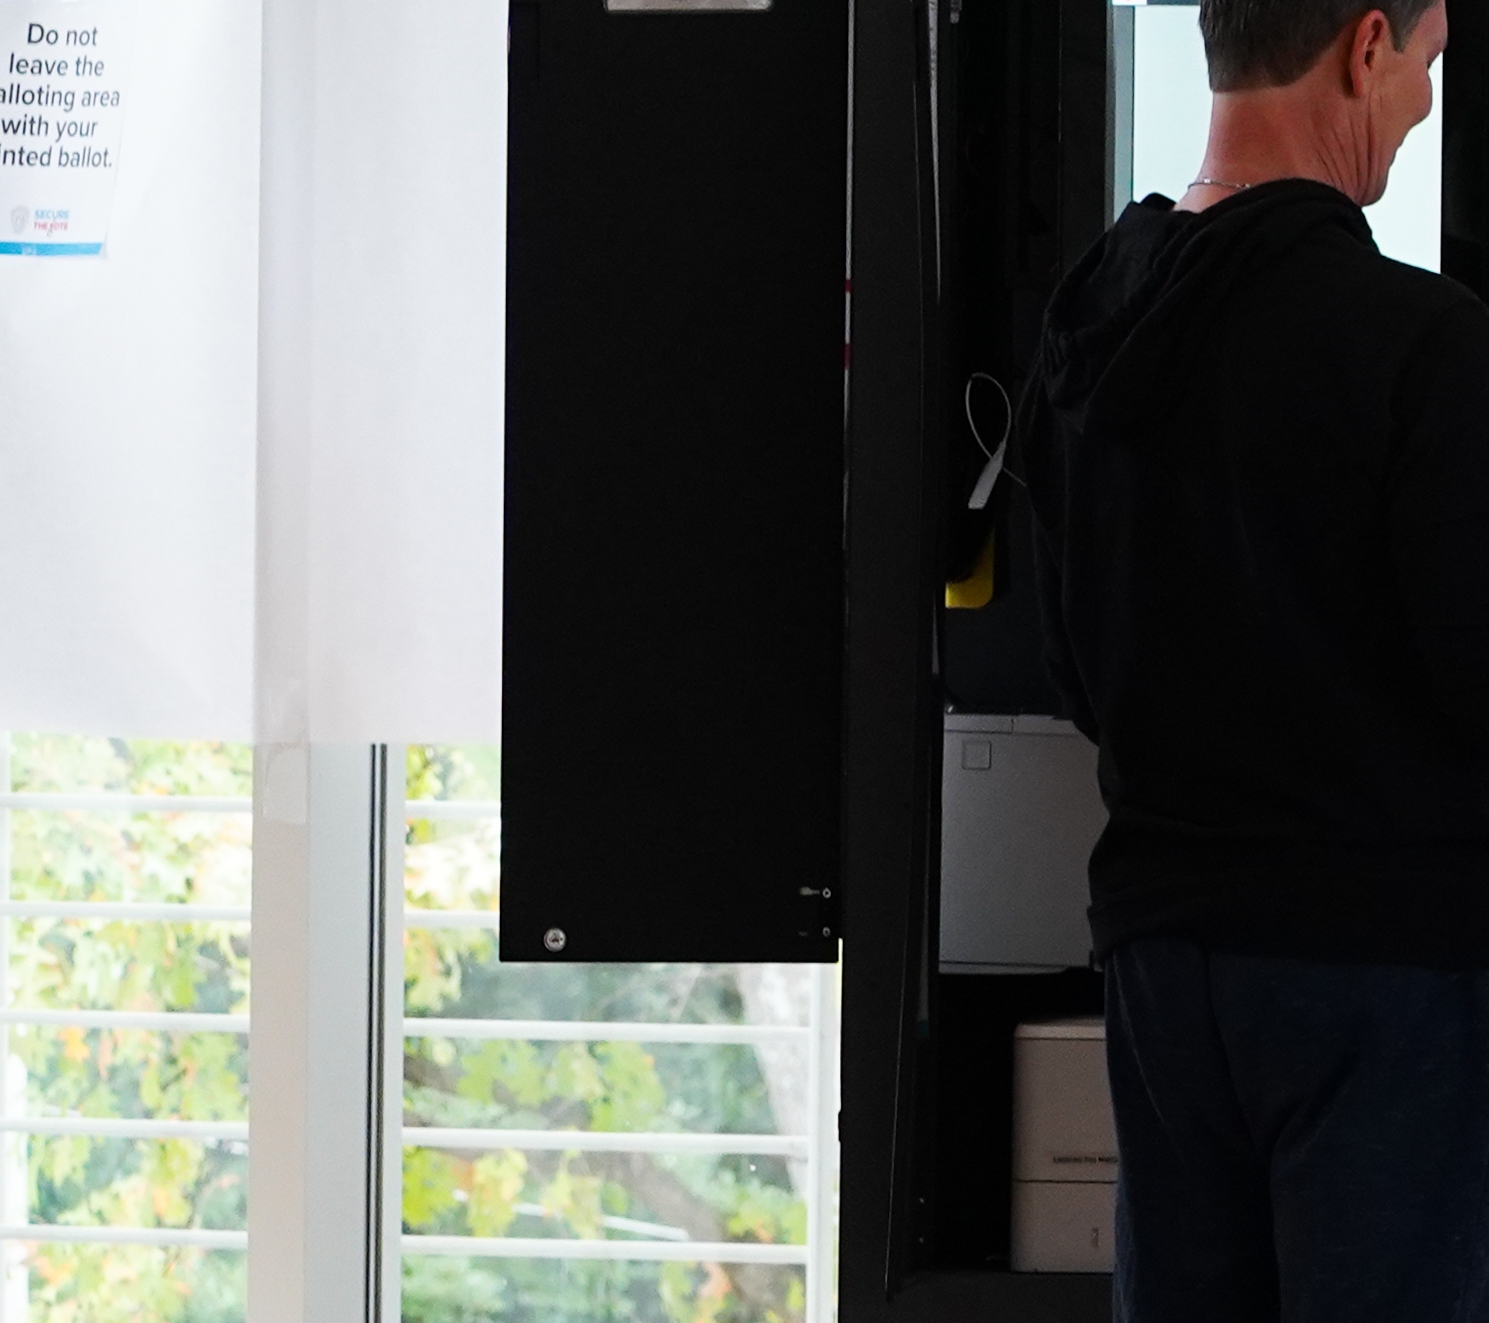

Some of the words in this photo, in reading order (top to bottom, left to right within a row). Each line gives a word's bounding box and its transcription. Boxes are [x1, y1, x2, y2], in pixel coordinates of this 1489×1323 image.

[27, 23, 59, 45] Do
[65, 26, 98, 47] not
[9, 52, 69, 77] leave
[75, 54, 105, 77] the
[81, 89, 120, 108] area
[1, 114, 49, 137] with
[55, 120, 98, 143] your
[58, 145, 113, 168] ballot.
[34, 208, 70, 221] SECURE
